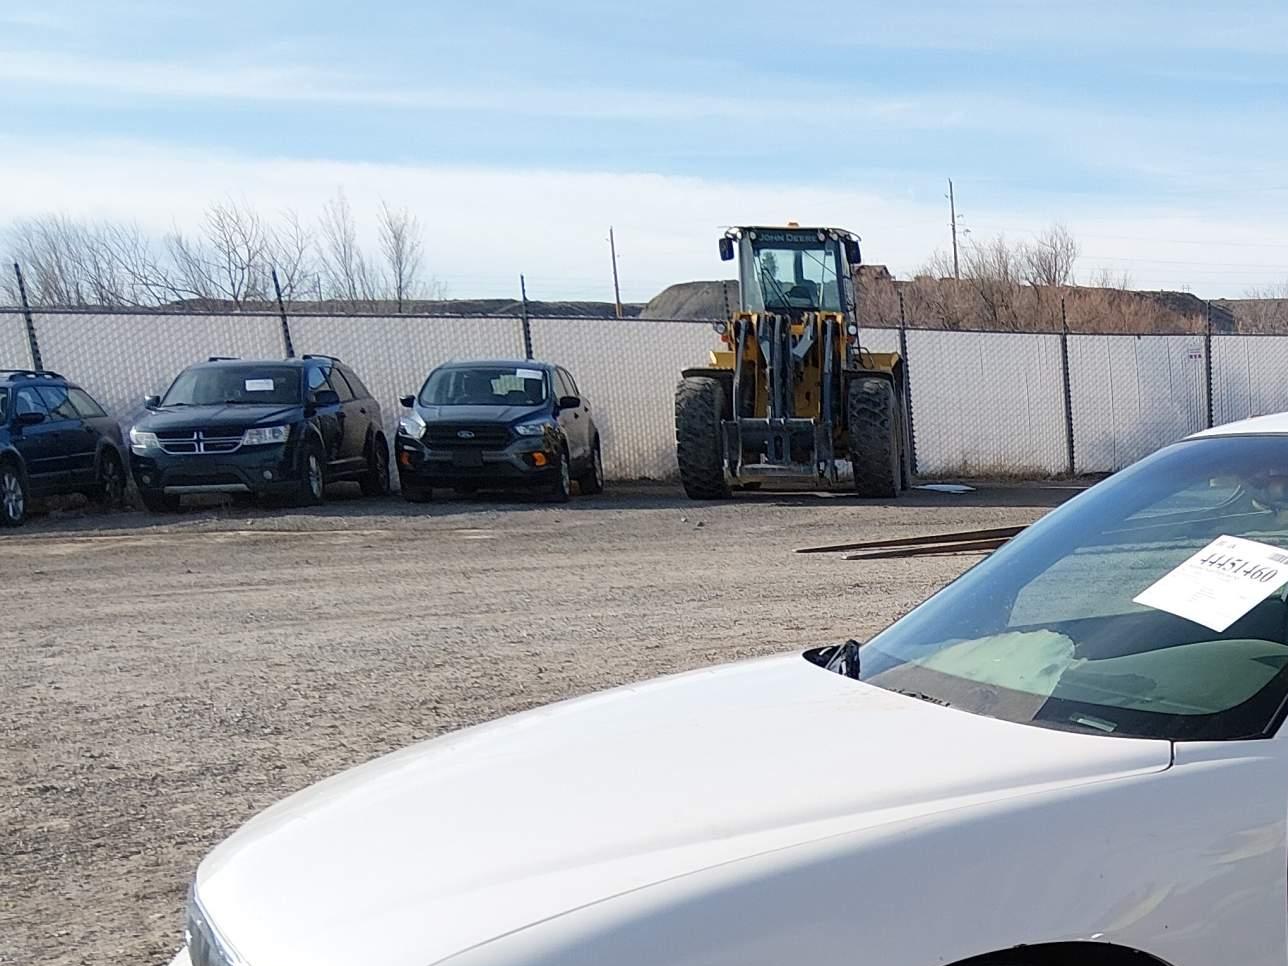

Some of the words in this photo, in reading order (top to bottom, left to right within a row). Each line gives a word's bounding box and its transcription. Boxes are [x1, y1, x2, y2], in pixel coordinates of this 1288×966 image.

[758, 231, 785, 241] JOHN
[786, 232, 817, 242] DEERE
[1199, 552, 1279, 583] 44451460
